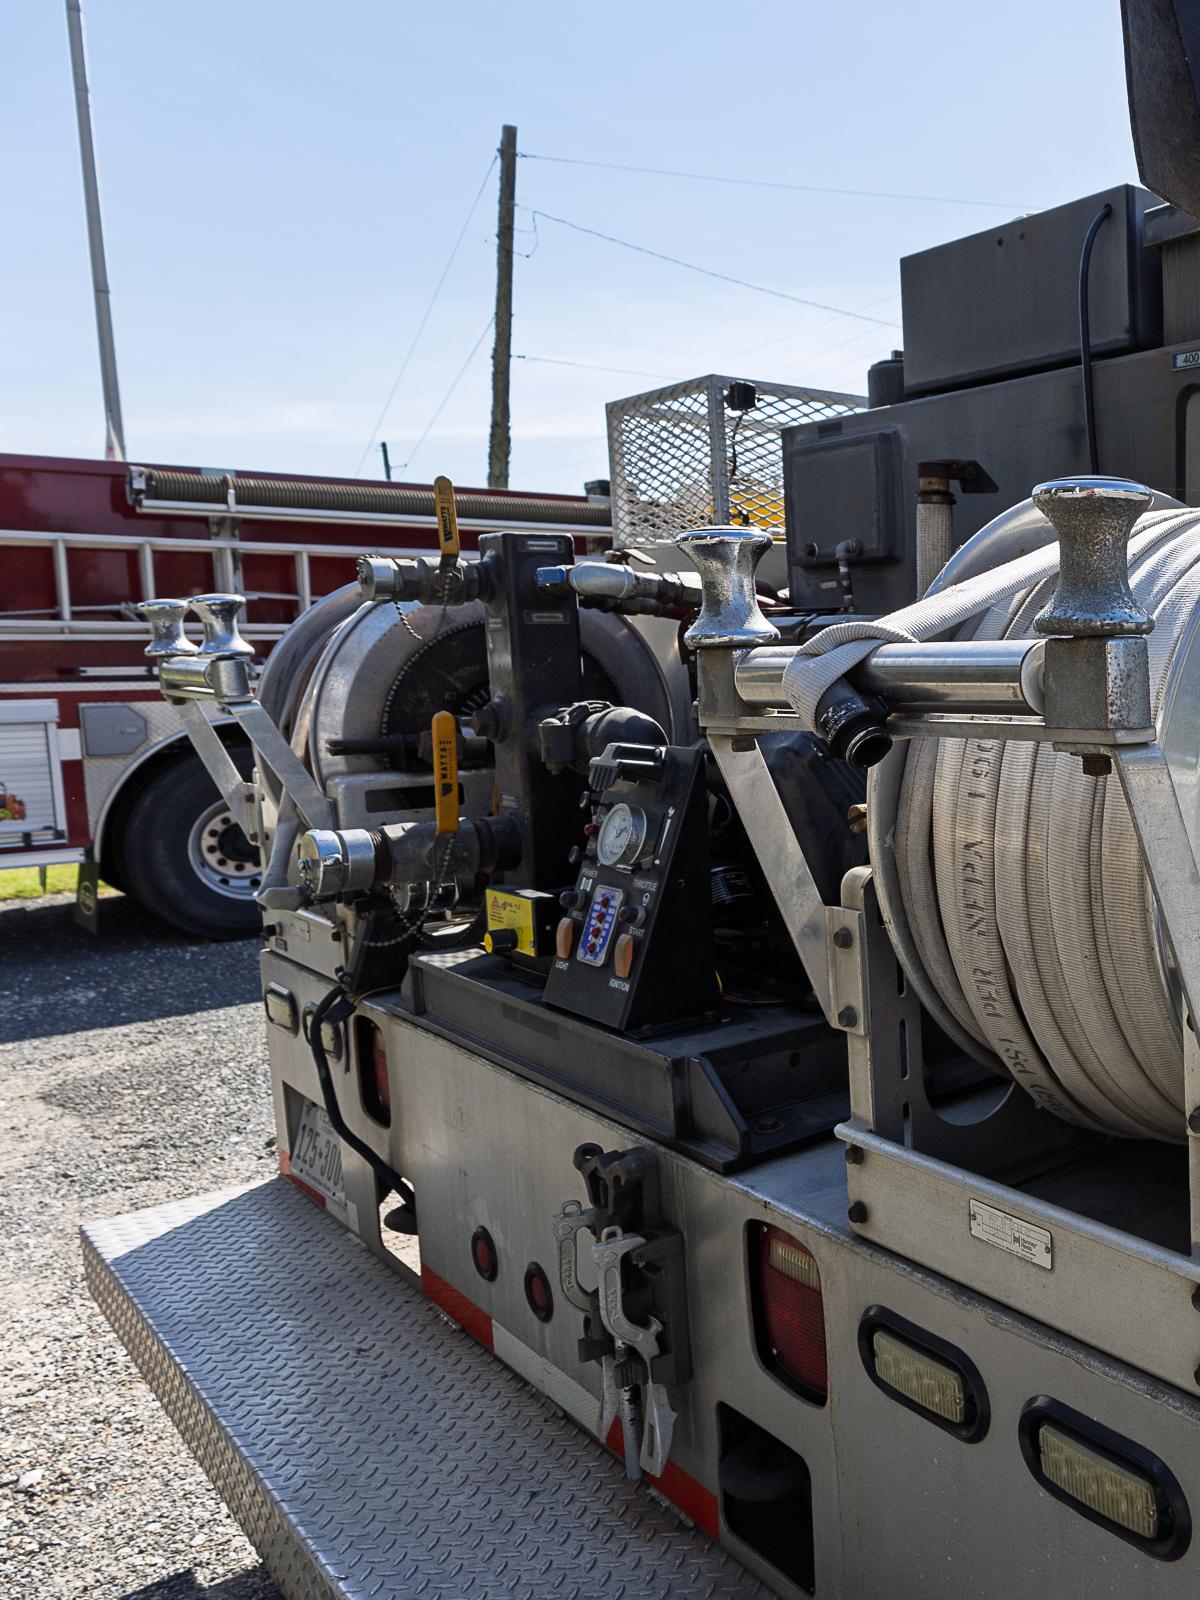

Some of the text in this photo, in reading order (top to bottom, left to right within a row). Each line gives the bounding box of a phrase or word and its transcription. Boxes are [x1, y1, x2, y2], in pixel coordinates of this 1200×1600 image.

[1183, 352, 1200, 364] 400
[439, 747, 449, 779] WATTS
[633, 878, 658, 892] THROTTLE
[963, 840, 988, 937] NFPA
[629, 926, 645, 937] START
[555, 960, 569, 970] LIGHT
[608, 978, 631, 992] IGNITION
